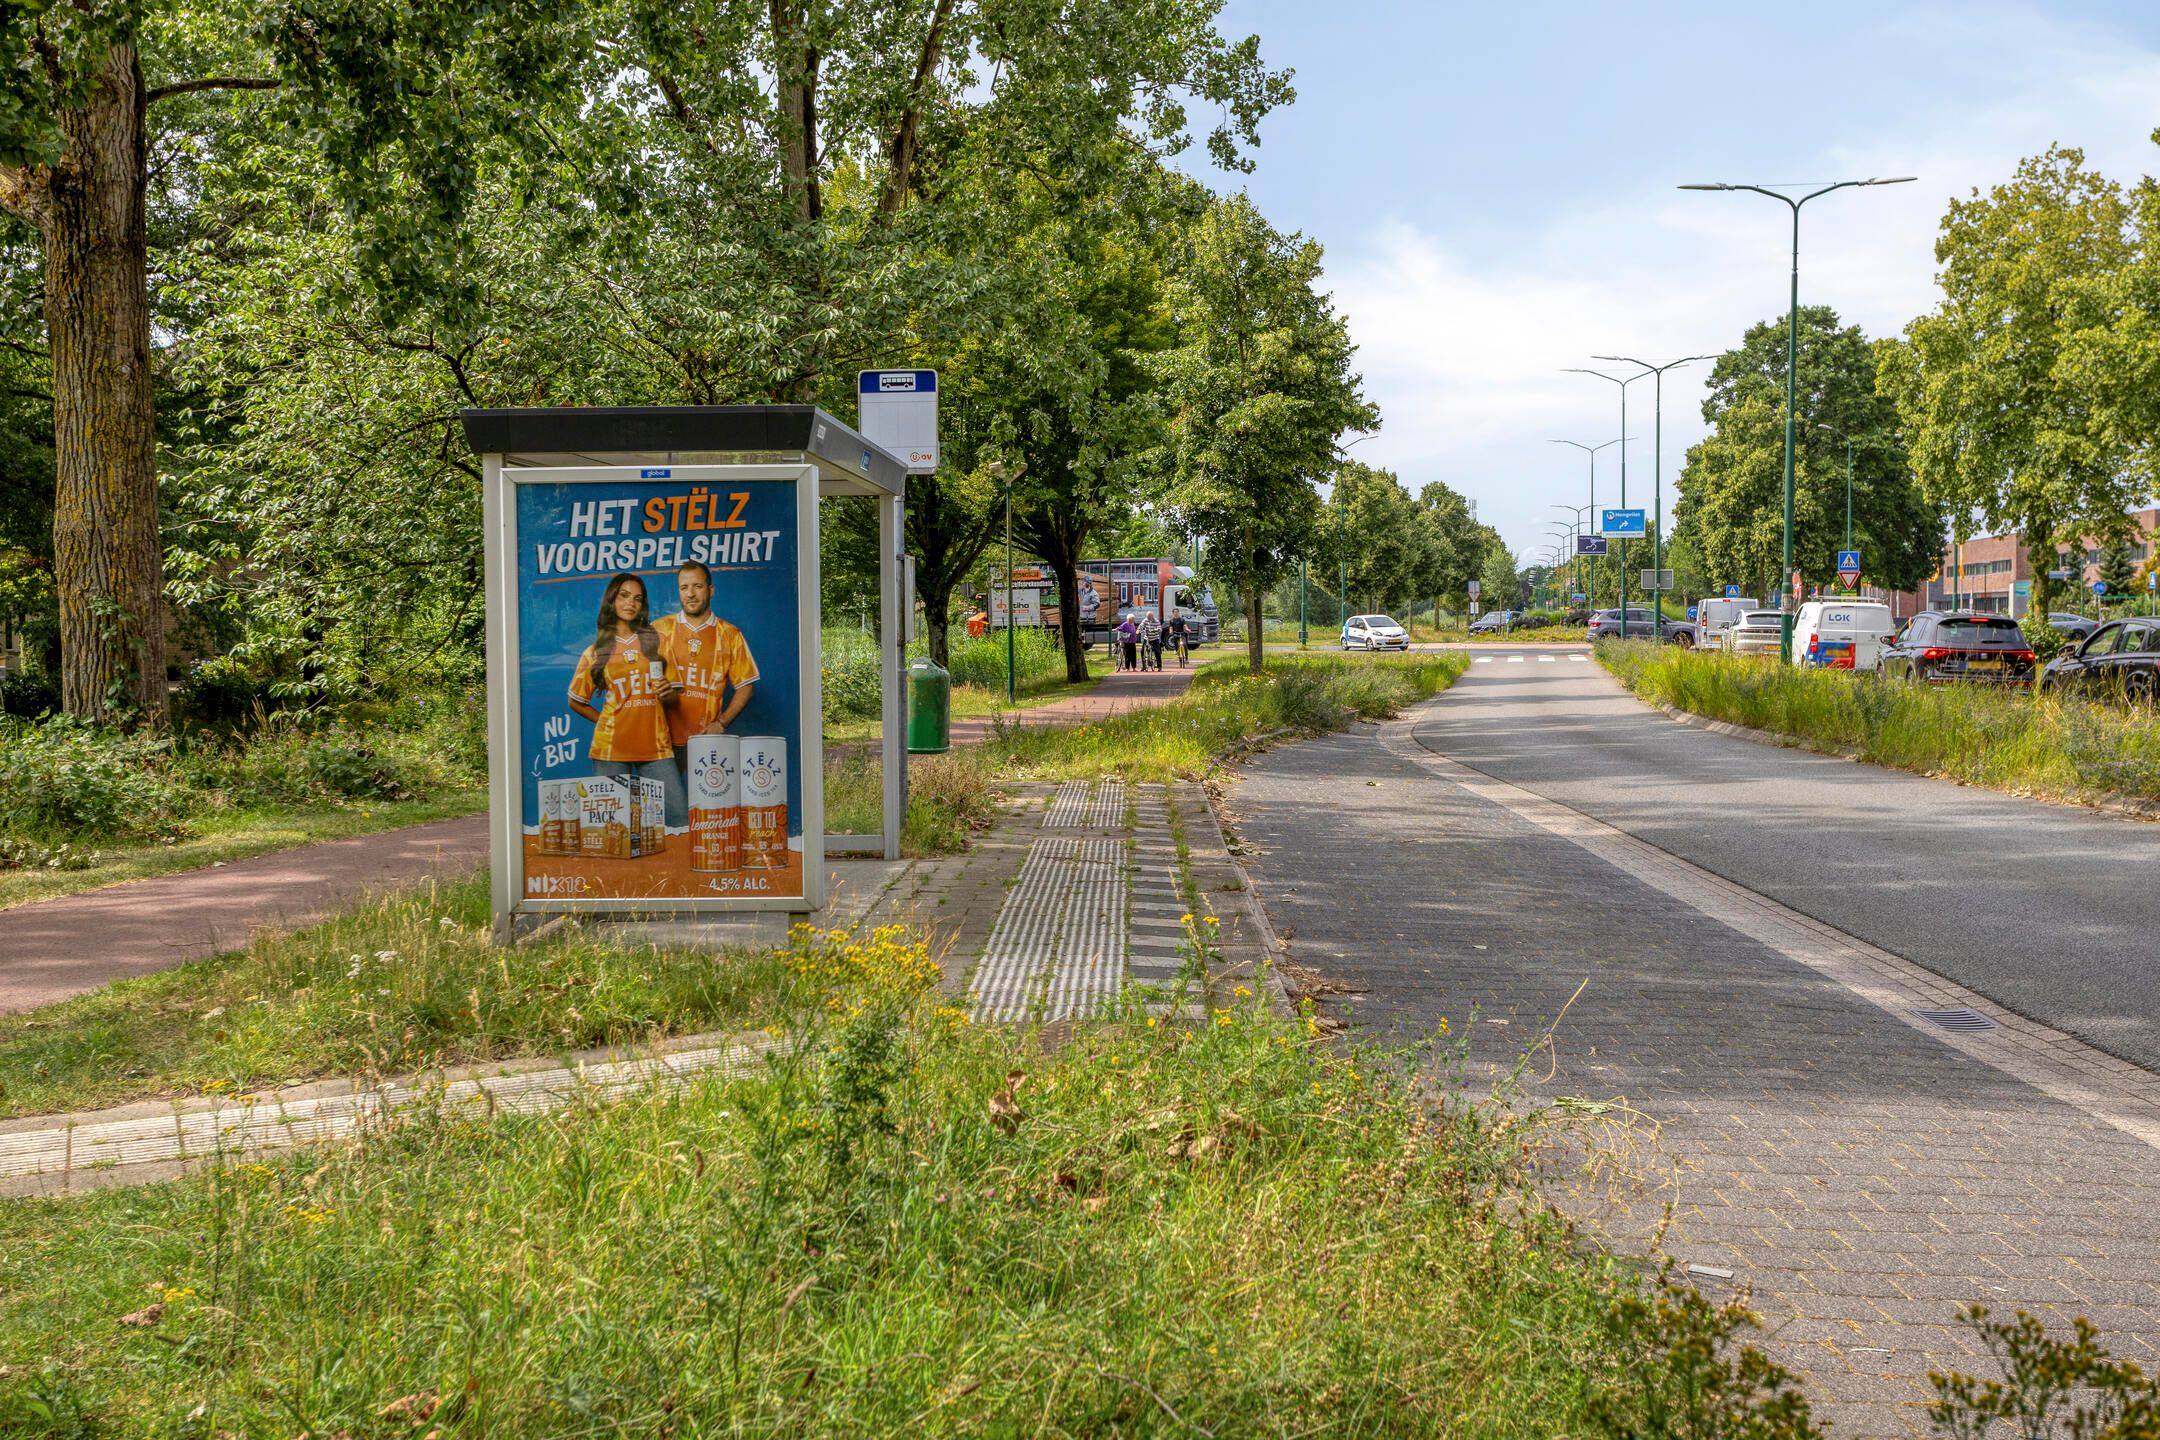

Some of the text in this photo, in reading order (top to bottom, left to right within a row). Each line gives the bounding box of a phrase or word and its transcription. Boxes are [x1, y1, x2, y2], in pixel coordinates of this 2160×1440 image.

[569, 487, 751, 538] HET STËLZ
[537, 531, 780, 574] VOORSPELSHIRT
[544, 714, 571, 742] NU
[543, 738, 579, 768] BIJ
[695, 750, 735, 777] STËLZ
[743, 752, 781, 777] STËLZ
[589, 782, 616, 794] STËLZ
[582, 797, 625, 812] ELFTAL
[589, 811, 616, 824] PACK
[690, 814, 741, 831] Lemonade
[743, 877, 770, 890] ALC.
